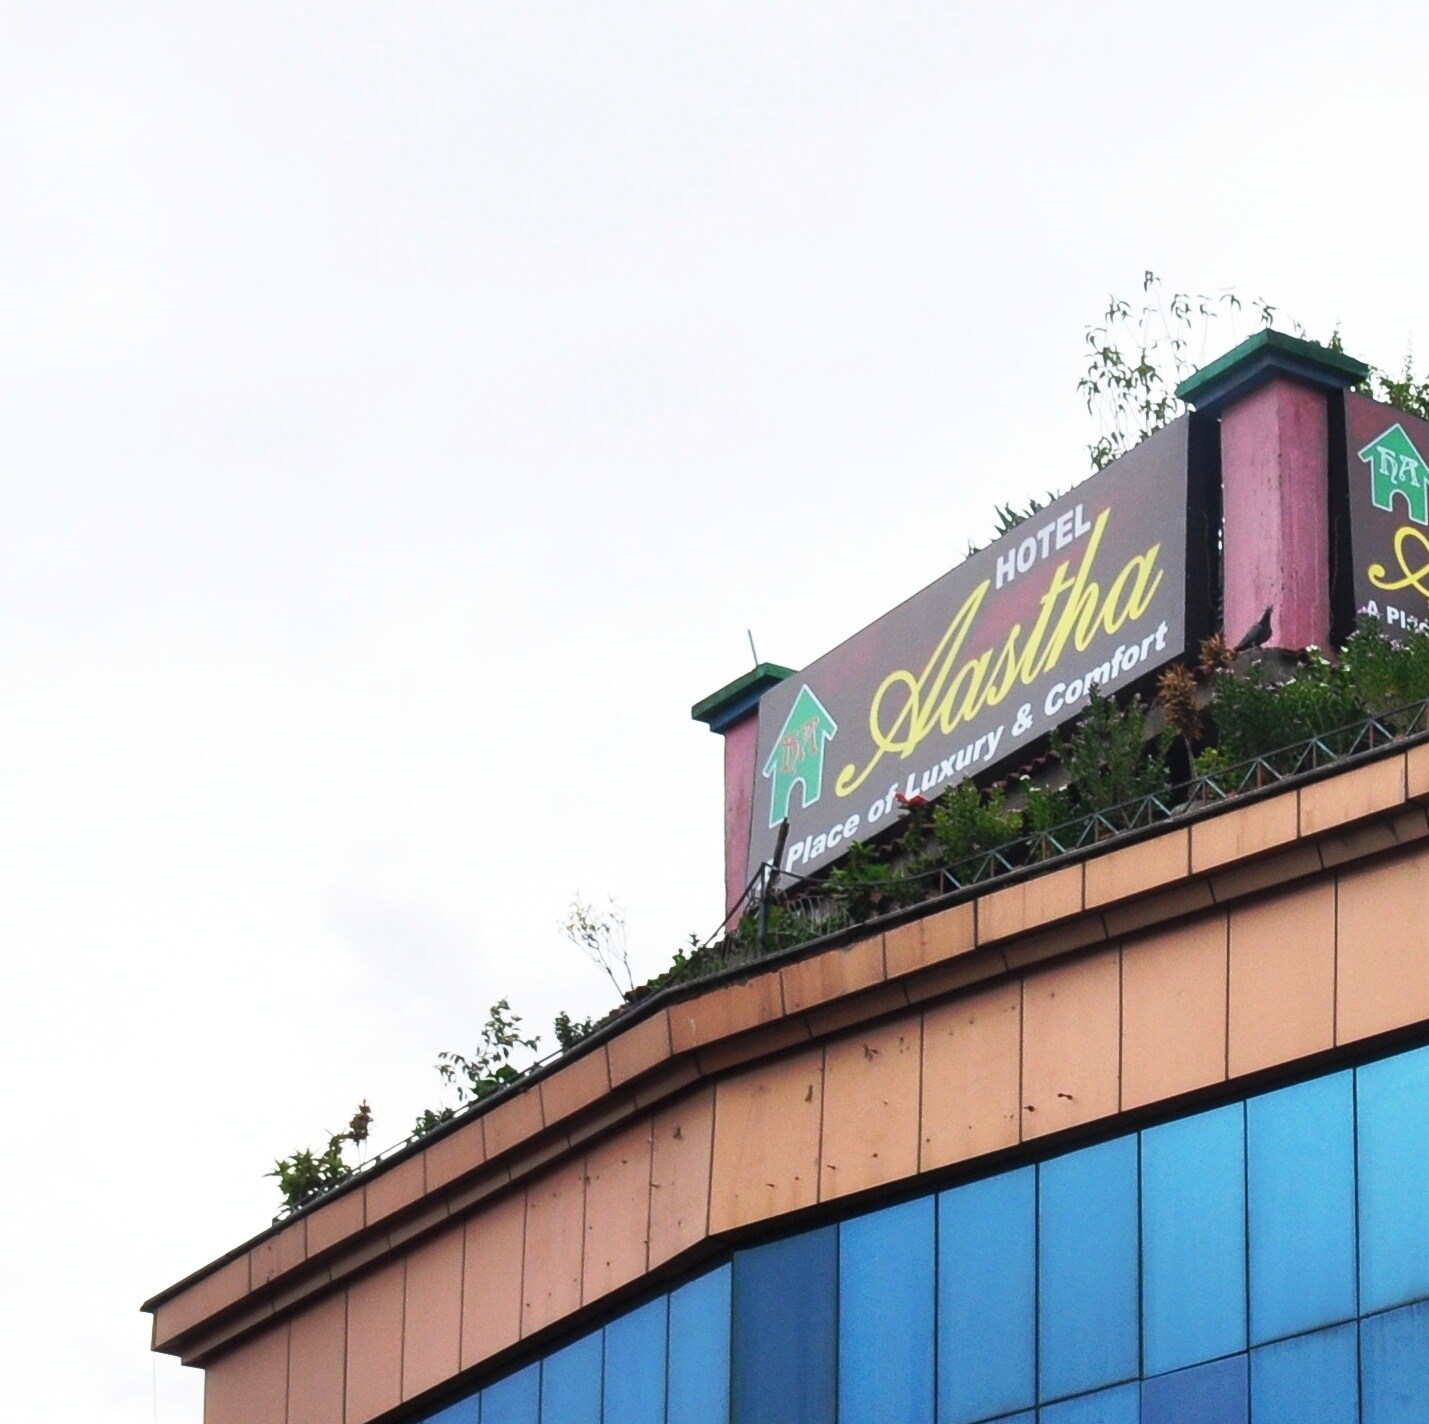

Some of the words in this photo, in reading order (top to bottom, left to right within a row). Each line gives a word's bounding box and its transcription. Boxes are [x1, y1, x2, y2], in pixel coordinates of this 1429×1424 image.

[835, 508, 1164, 797] Aastha
[995, 503, 1091, 589] HOTEL
[785, 813, 861, 874] Place
[867, 782, 899, 824] of
[904, 724, 1005, 801] Luxury
[1011, 703, 1034, 737] &
[1044, 620, 1169, 716] Comfort
